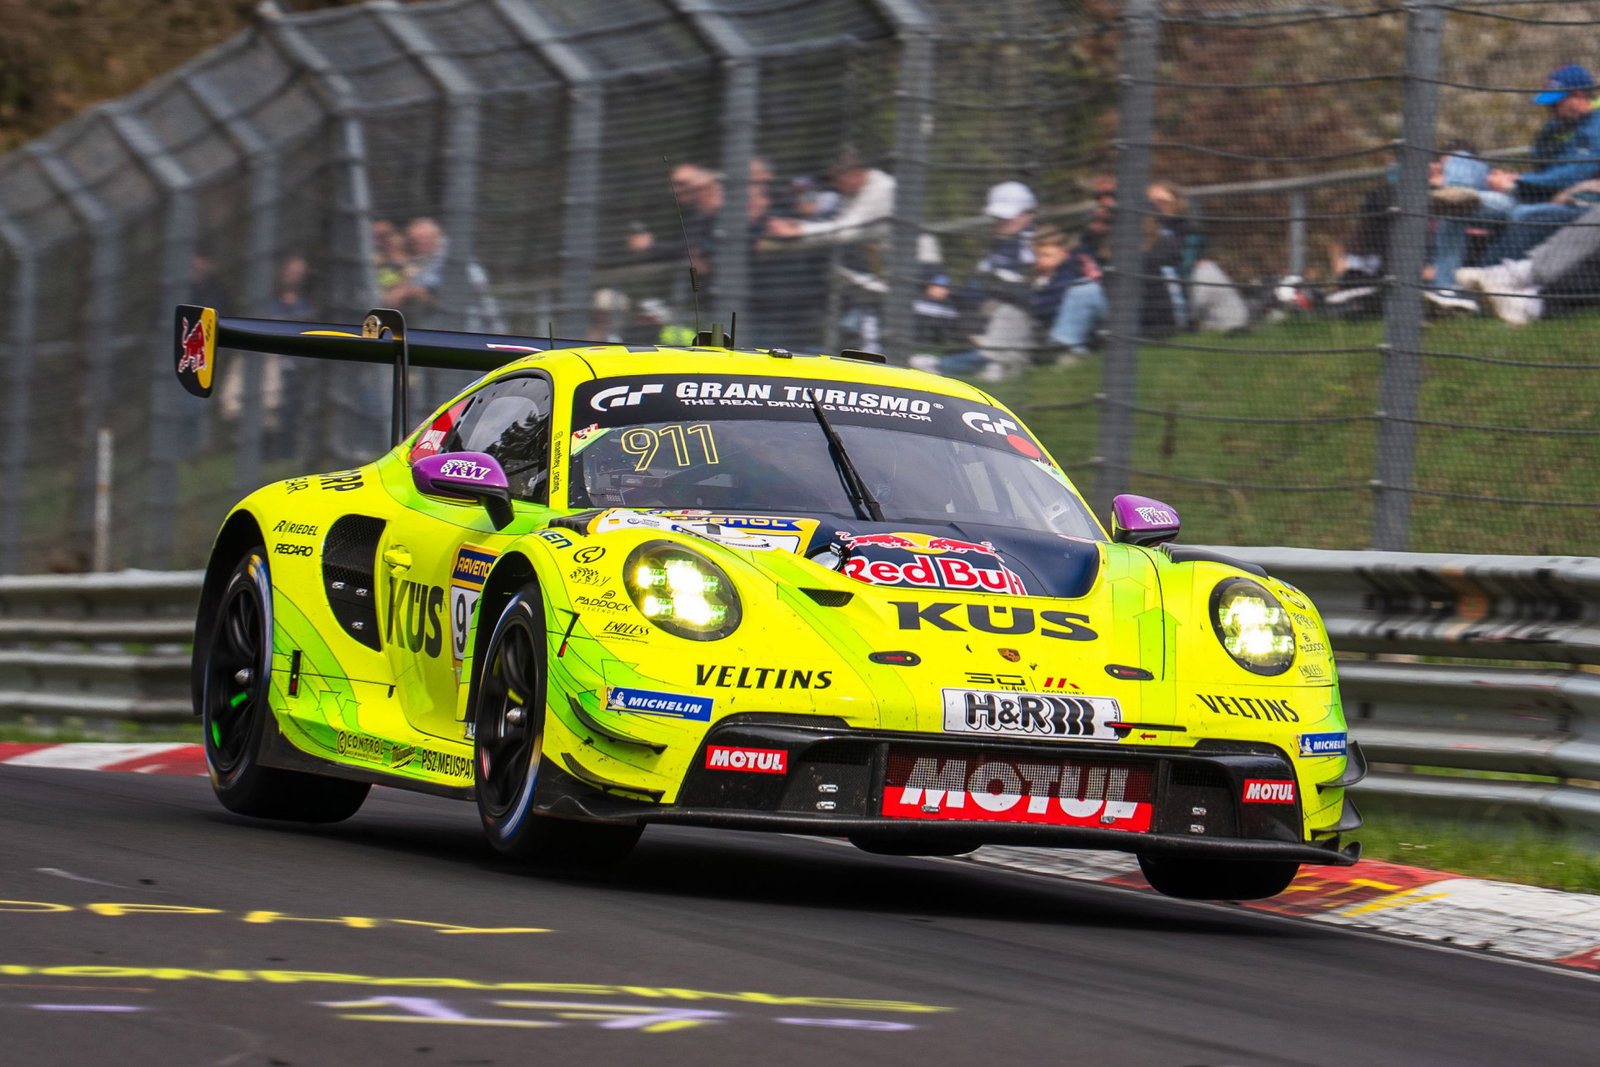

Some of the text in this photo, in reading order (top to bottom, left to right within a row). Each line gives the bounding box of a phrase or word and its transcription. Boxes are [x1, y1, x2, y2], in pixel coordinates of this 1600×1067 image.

[676, 382, 771, 399] GRAN
[719, 399, 763, 407] REAL
[837, 405, 932, 422] SIMULATOR
[621, 424, 720, 472] 911
[288, 522, 318, 536] RIEDEL
[274, 543, 313, 557] RECARO
[840, 554, 1028, 597] Red Bull
[575, 596, 632, 612] PADDOCK
[387, 576, 444, 658] KÜS
[888, 601, 1098, 642] KÜS
[604, 621, 650, 636] ENDLESS
[696, 664, 832, 690] VELTINS
[964, 672, 1026, 686] 30
[627, 696, 703, 714] MICHELIN
[965, 693, 1050, 732] H&R
[1195, 693, 1299, 723] VELTINS
[347, 733, 384, 755] CONTROL
[1313, 740, 1346, 750] MICHELIN
[709, 749, 784, 771] MOTUL
[900, 757, 1138, 819] MOTUL
[1245, 782, 1294, 801] MOTUL
